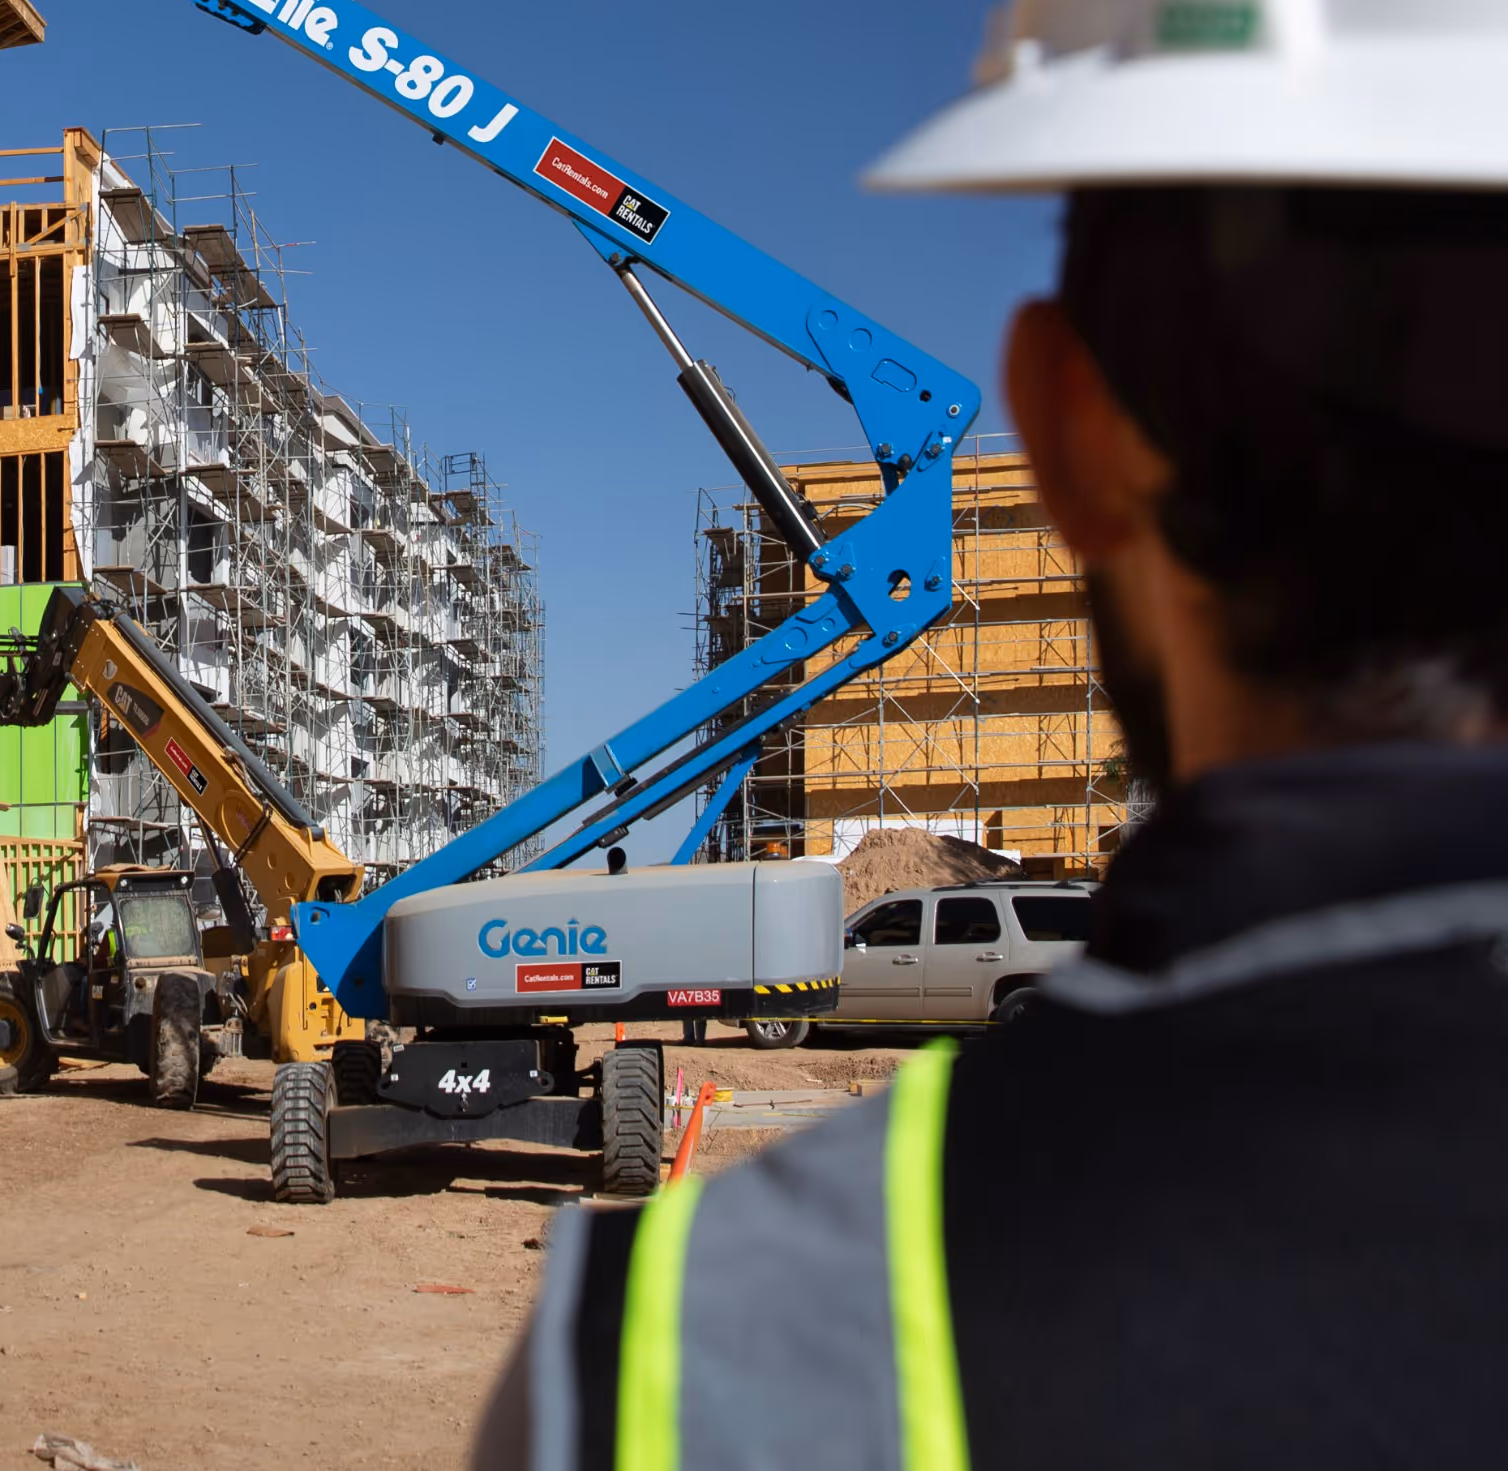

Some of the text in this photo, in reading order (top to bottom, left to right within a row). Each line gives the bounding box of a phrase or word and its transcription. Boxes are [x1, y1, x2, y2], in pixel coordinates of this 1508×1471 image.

[348, 27, 474, 118] S-80
[467, 103, 519, 143] J
[551, 156, 609, 200] CatRentals.com
[622, 195, 641, 212] CAT
[616, 204, 653, 234] RENTALS
[114, 685, 132, 716] CAT
[478, 917, 608, 959] Genie
[524, 974, 574, 984] CatRentals.com
[585, 967, 599, 976] CAT
[585, 974, 616, 985] RENTALS
[668, 989, 720, 1003] VA7B35
[438, 1069, 491, 1094] 4x4
